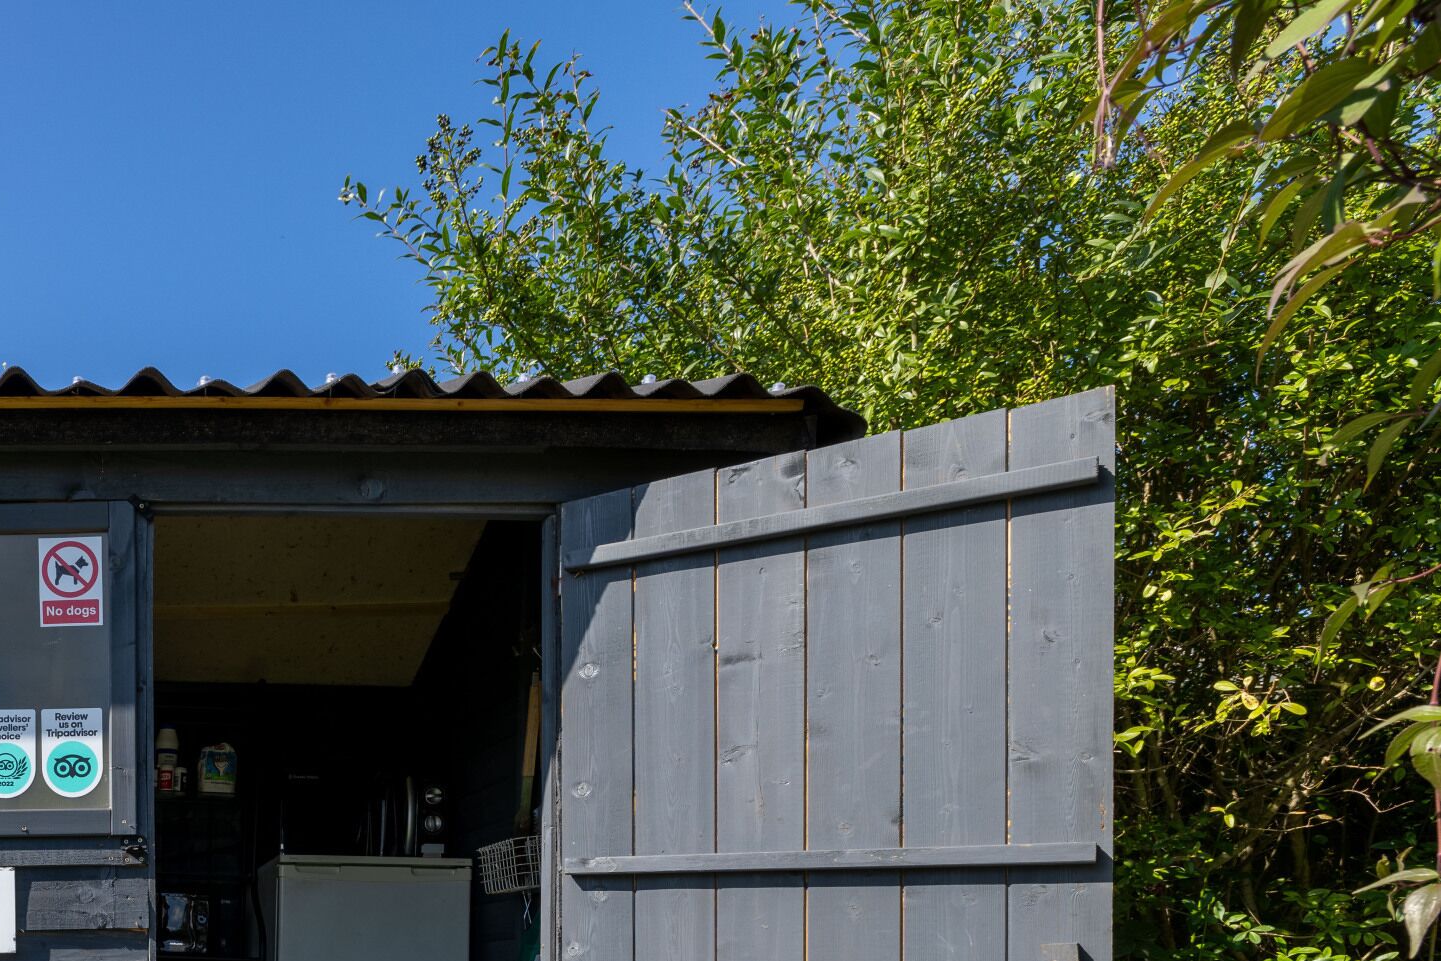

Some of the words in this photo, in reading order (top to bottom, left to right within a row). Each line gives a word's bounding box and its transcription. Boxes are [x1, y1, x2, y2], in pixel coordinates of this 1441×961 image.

[46, 605, 63, 617] No
[67, 606, 97, 617] dogs
[70, 721, 83, 729] on
[45, 728, 99, 739] Tripadvisor
